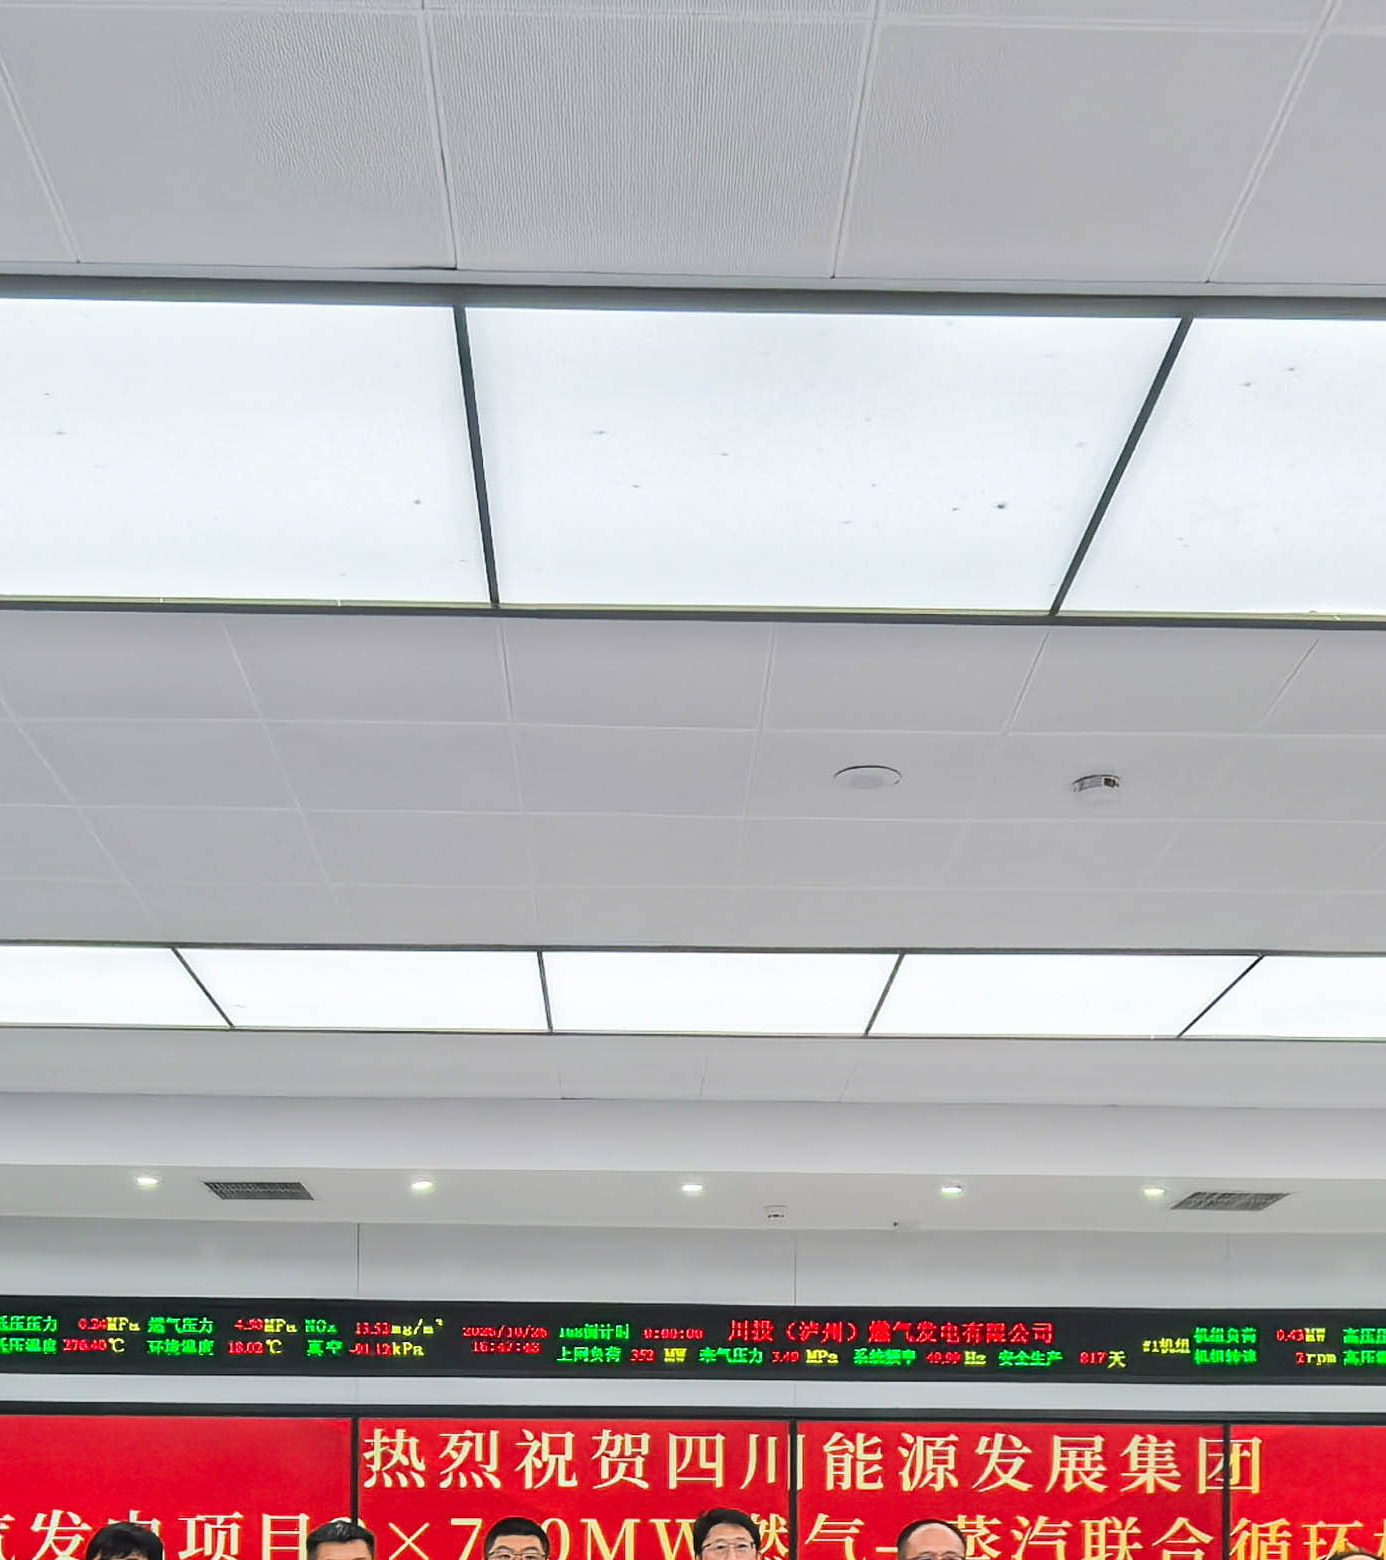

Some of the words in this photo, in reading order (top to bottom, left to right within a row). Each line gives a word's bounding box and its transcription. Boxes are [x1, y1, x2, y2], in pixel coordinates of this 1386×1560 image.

[362, 1429, 1264, 1494] 热烈祝贺四川能源发展集团
